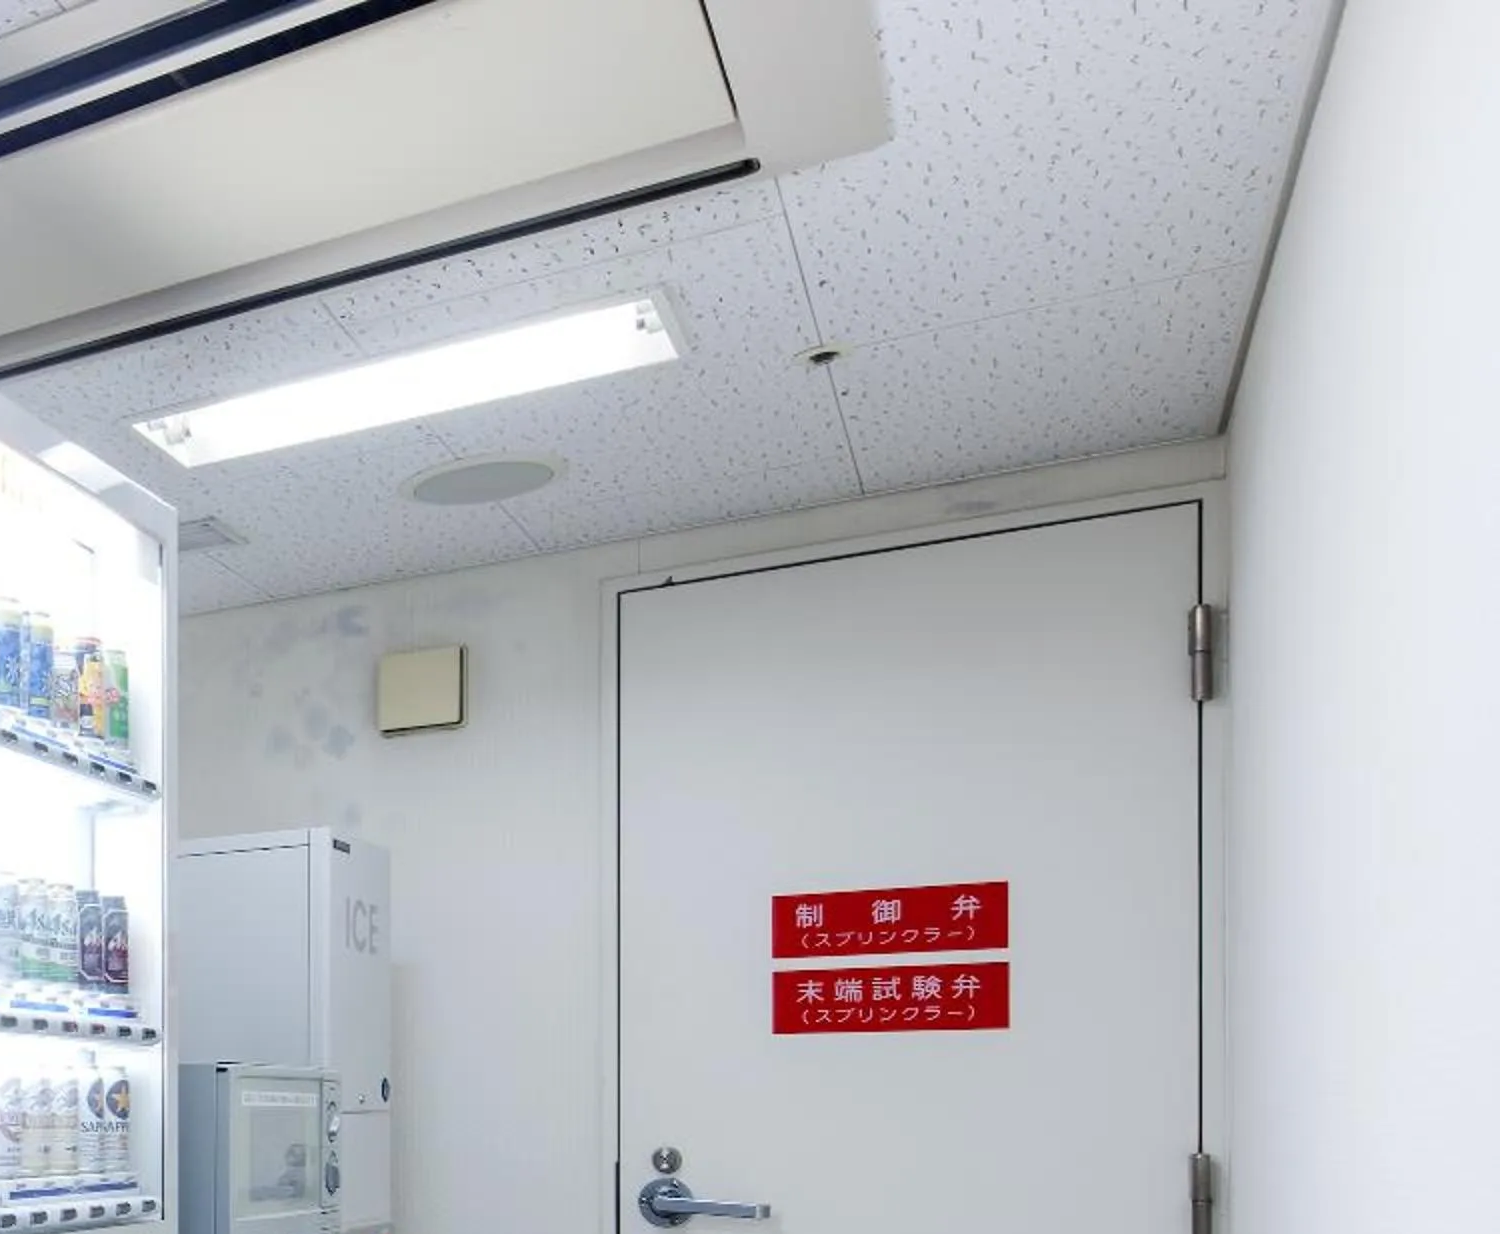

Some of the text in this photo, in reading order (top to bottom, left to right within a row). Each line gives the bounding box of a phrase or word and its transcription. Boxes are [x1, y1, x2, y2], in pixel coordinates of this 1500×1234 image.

[344, 896, 380, 955] ICE
[794, 894, 983, 929] 制御弁
[795, 974, 983, 1005] 末端試験弁
